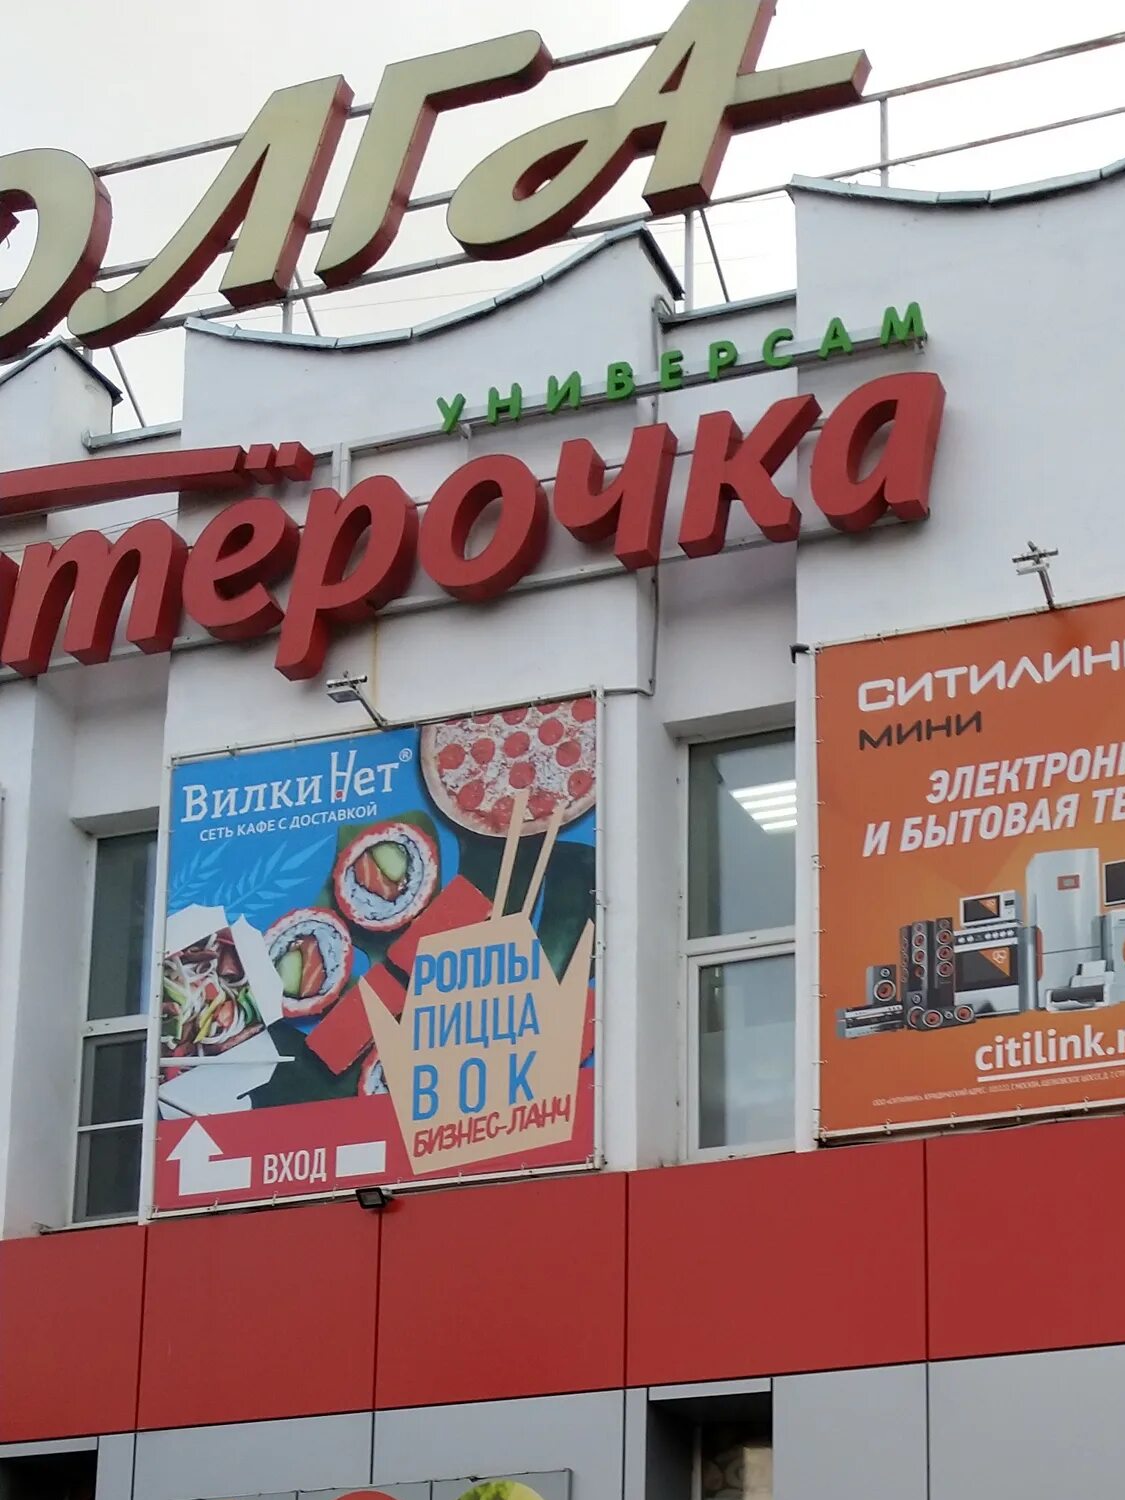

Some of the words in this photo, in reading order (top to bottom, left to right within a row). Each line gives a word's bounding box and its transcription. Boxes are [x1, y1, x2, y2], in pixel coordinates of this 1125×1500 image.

[437, 301, 927, 434] УНИВЕРСАМ
[0, 372, 947, 681] тёрочка
[858, 711, 982, 751] МИНИ
[199, 826, 234, 843] СЕТЬ
[236, 819, 275, 838] КАФЕ
[278, 816, 288, 830] С
[289, 801, 378, 829] ДОСТАВКОЙ
[862, 822, 890, 858] И
[899, 793, 1081, 852] БЫТОВАЯ
[413, 938, 541, 996] РОЛЛЫ
[413, 992, 541, 1052] ПИЦЦА
[413, 1094, 572, 1159] БИЗНЕС-ЛАНЧ
[262, 1148, 327, 1186] ВХОД
